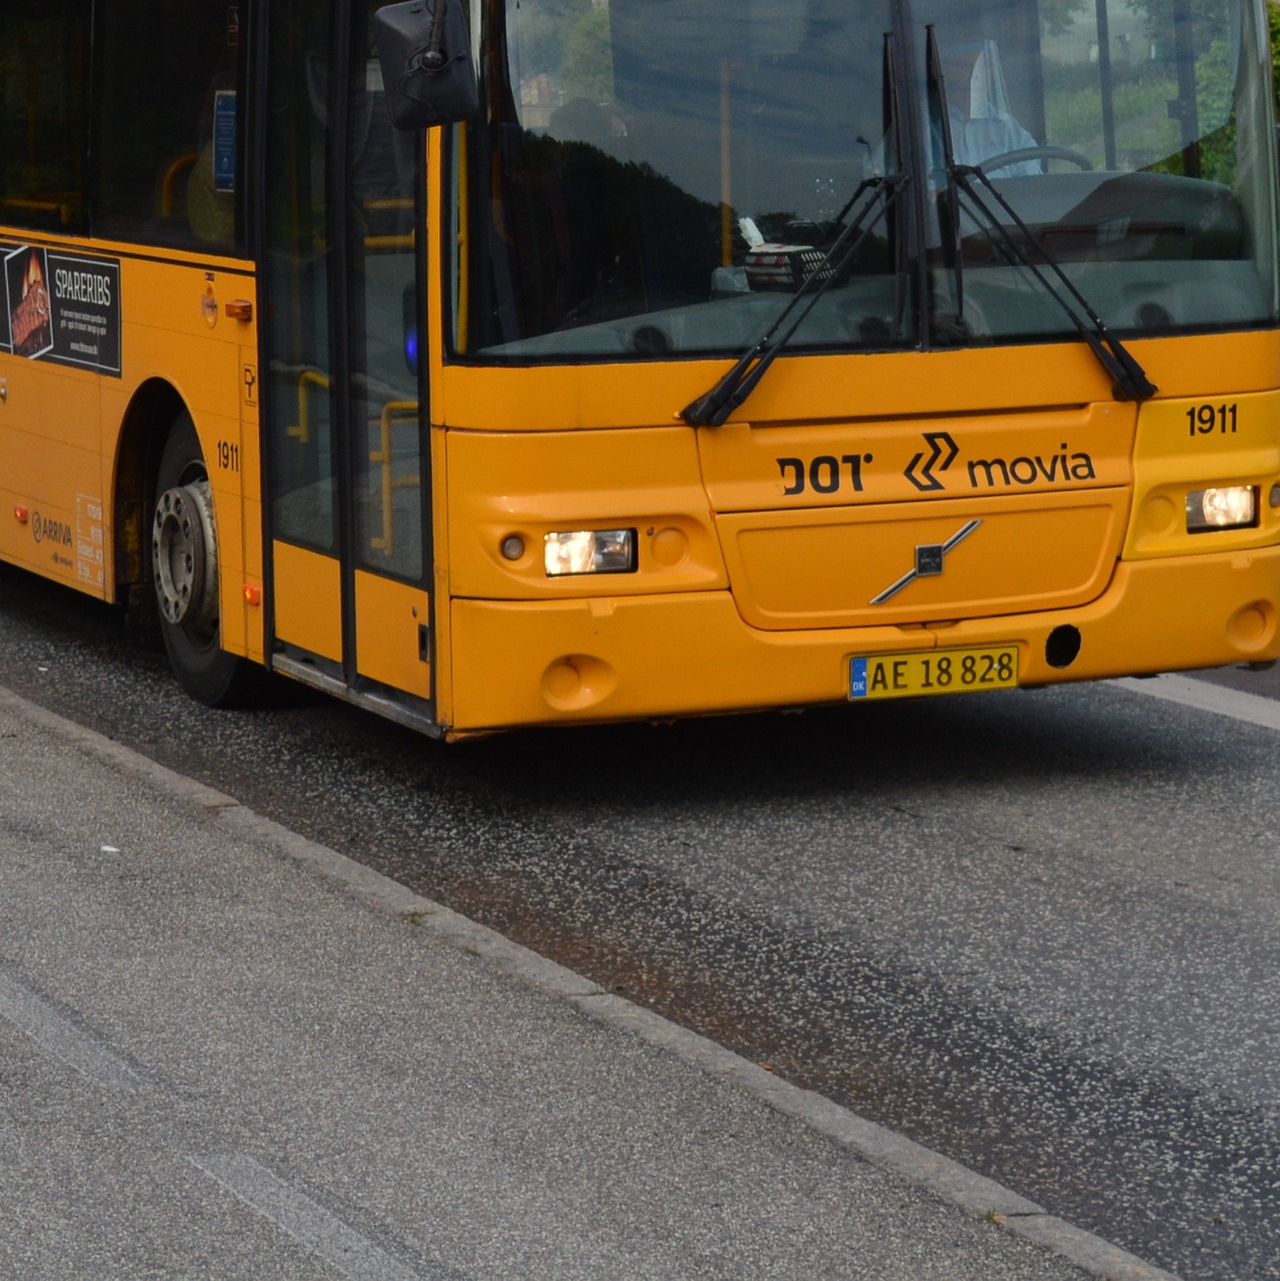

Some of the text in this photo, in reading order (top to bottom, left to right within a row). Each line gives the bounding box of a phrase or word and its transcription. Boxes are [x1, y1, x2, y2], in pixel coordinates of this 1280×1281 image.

[55, 269, 111, 306] SPARERIBS
[1186, 403, 1237, 436] 1911
[217, 440, 239, 472] 1911
[967, 442, 1096, 488] movia
[43, 518, 72, 548] ARRIVA
[852, 681, 865, 692] DK
[871, 652, 1014, 691] AE 18 828
